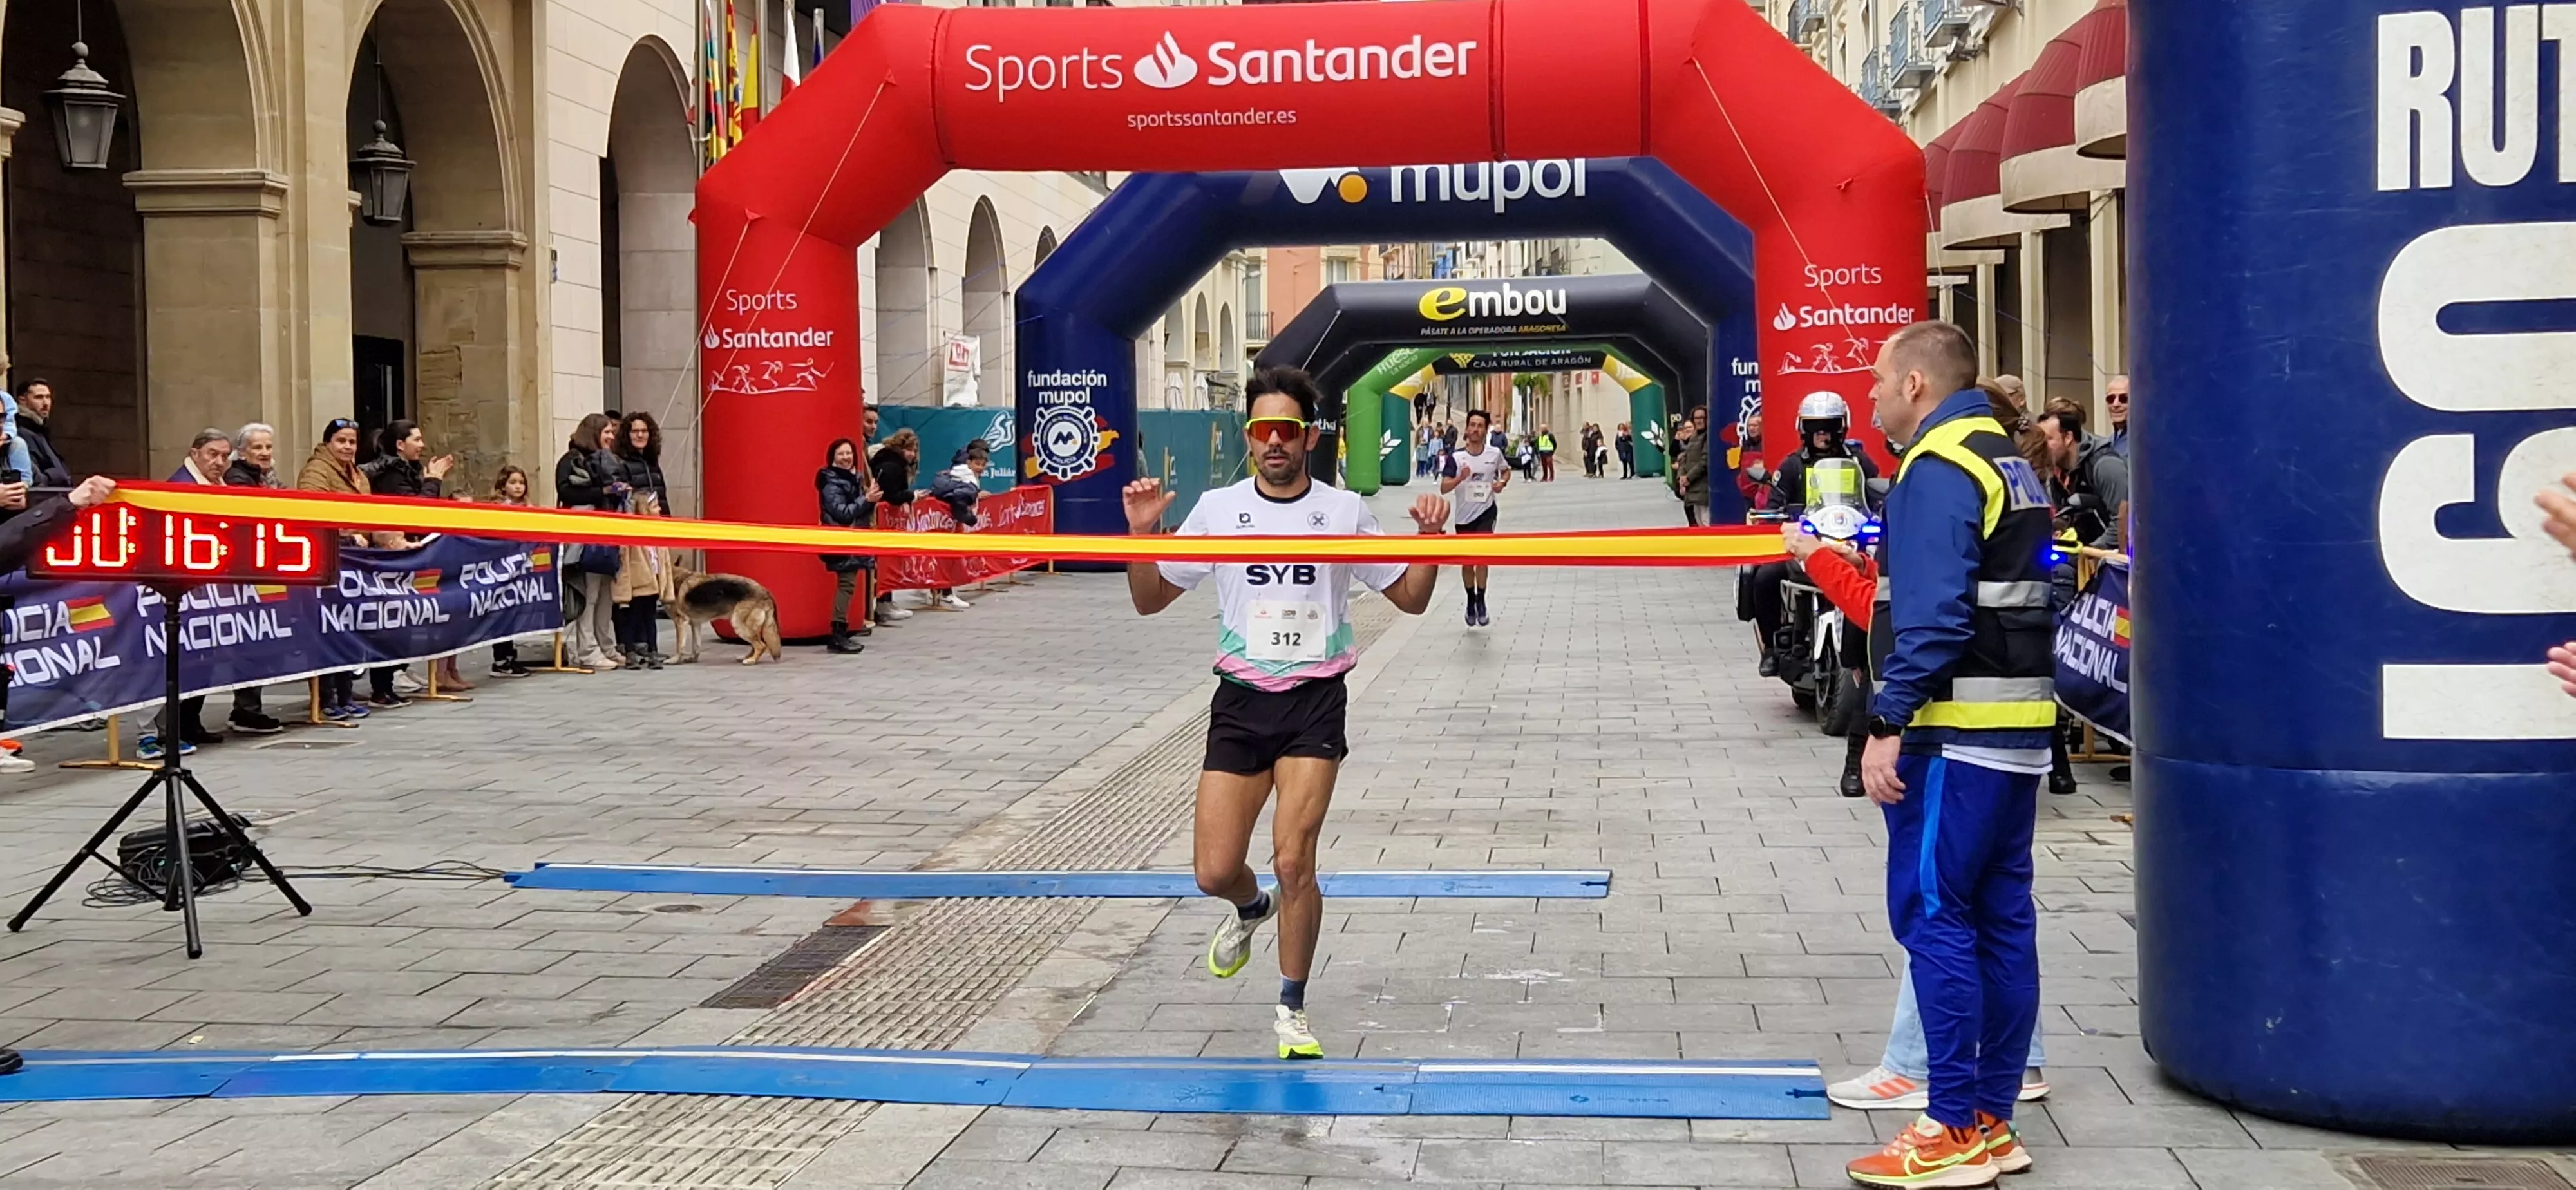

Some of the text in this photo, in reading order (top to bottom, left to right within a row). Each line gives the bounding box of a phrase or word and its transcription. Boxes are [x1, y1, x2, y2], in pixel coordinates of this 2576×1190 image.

[964, 35, 1477, 102] Sports Santander
[1127, 108, 1296, 131] sportssantander.es
[1390, 156, 1586, 213] mupol
[1804, 263, 1882, 291] Sports
[726, 289, 798, 316] Sports
[1419, 282, 1567, 321] embou
[1799, 303, 1915, 328] Santander
[722, 327, 834, 349] Santander
[1473, 355, 1591, 368] CAJA RURAL DE ARAGÓN
[1731, 357, 1759, 375] fun
[1027, 368, 1108, 388] fundación
[1038, 386, 1090, 406] mupol
[1245, 564, 1317, 585] SYB
[469, 577, 553, 619] NACIONAL
[321, 598, 451, 634] NACIONAL
[1271, 631, 1302, 646] 312
[2052, 624, 2128, 694] NACIONAL
